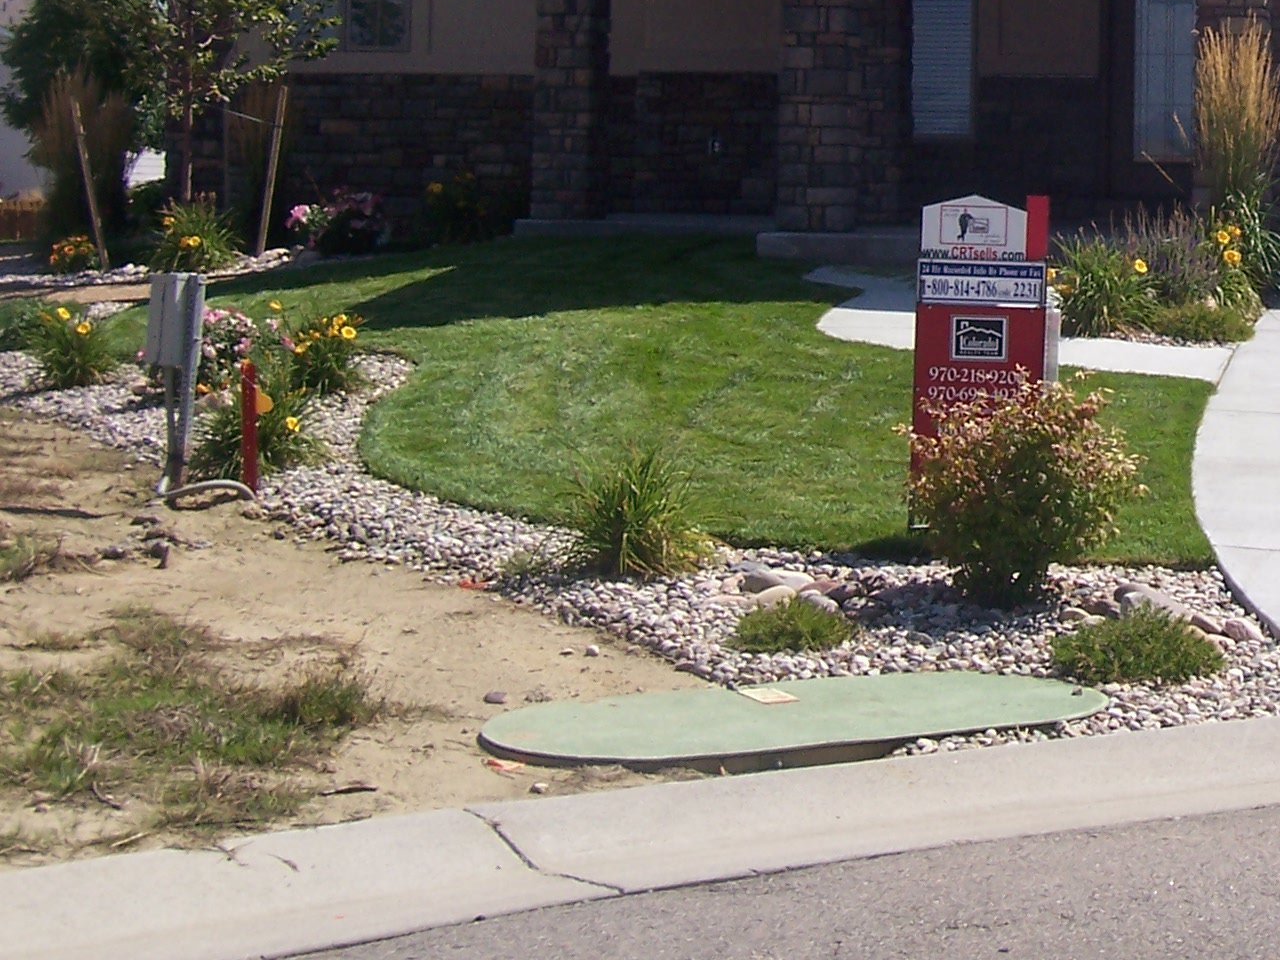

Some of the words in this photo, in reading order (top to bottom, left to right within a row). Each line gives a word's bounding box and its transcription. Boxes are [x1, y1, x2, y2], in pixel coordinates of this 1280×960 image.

[921, 246, 1024, 261] www.CRTsells.com
[921, 278, 997, 297] 1-800-814-4786
[1013, 282, 1037, 297] 2231
[929, 366, 1024, 385] 970-218-920
